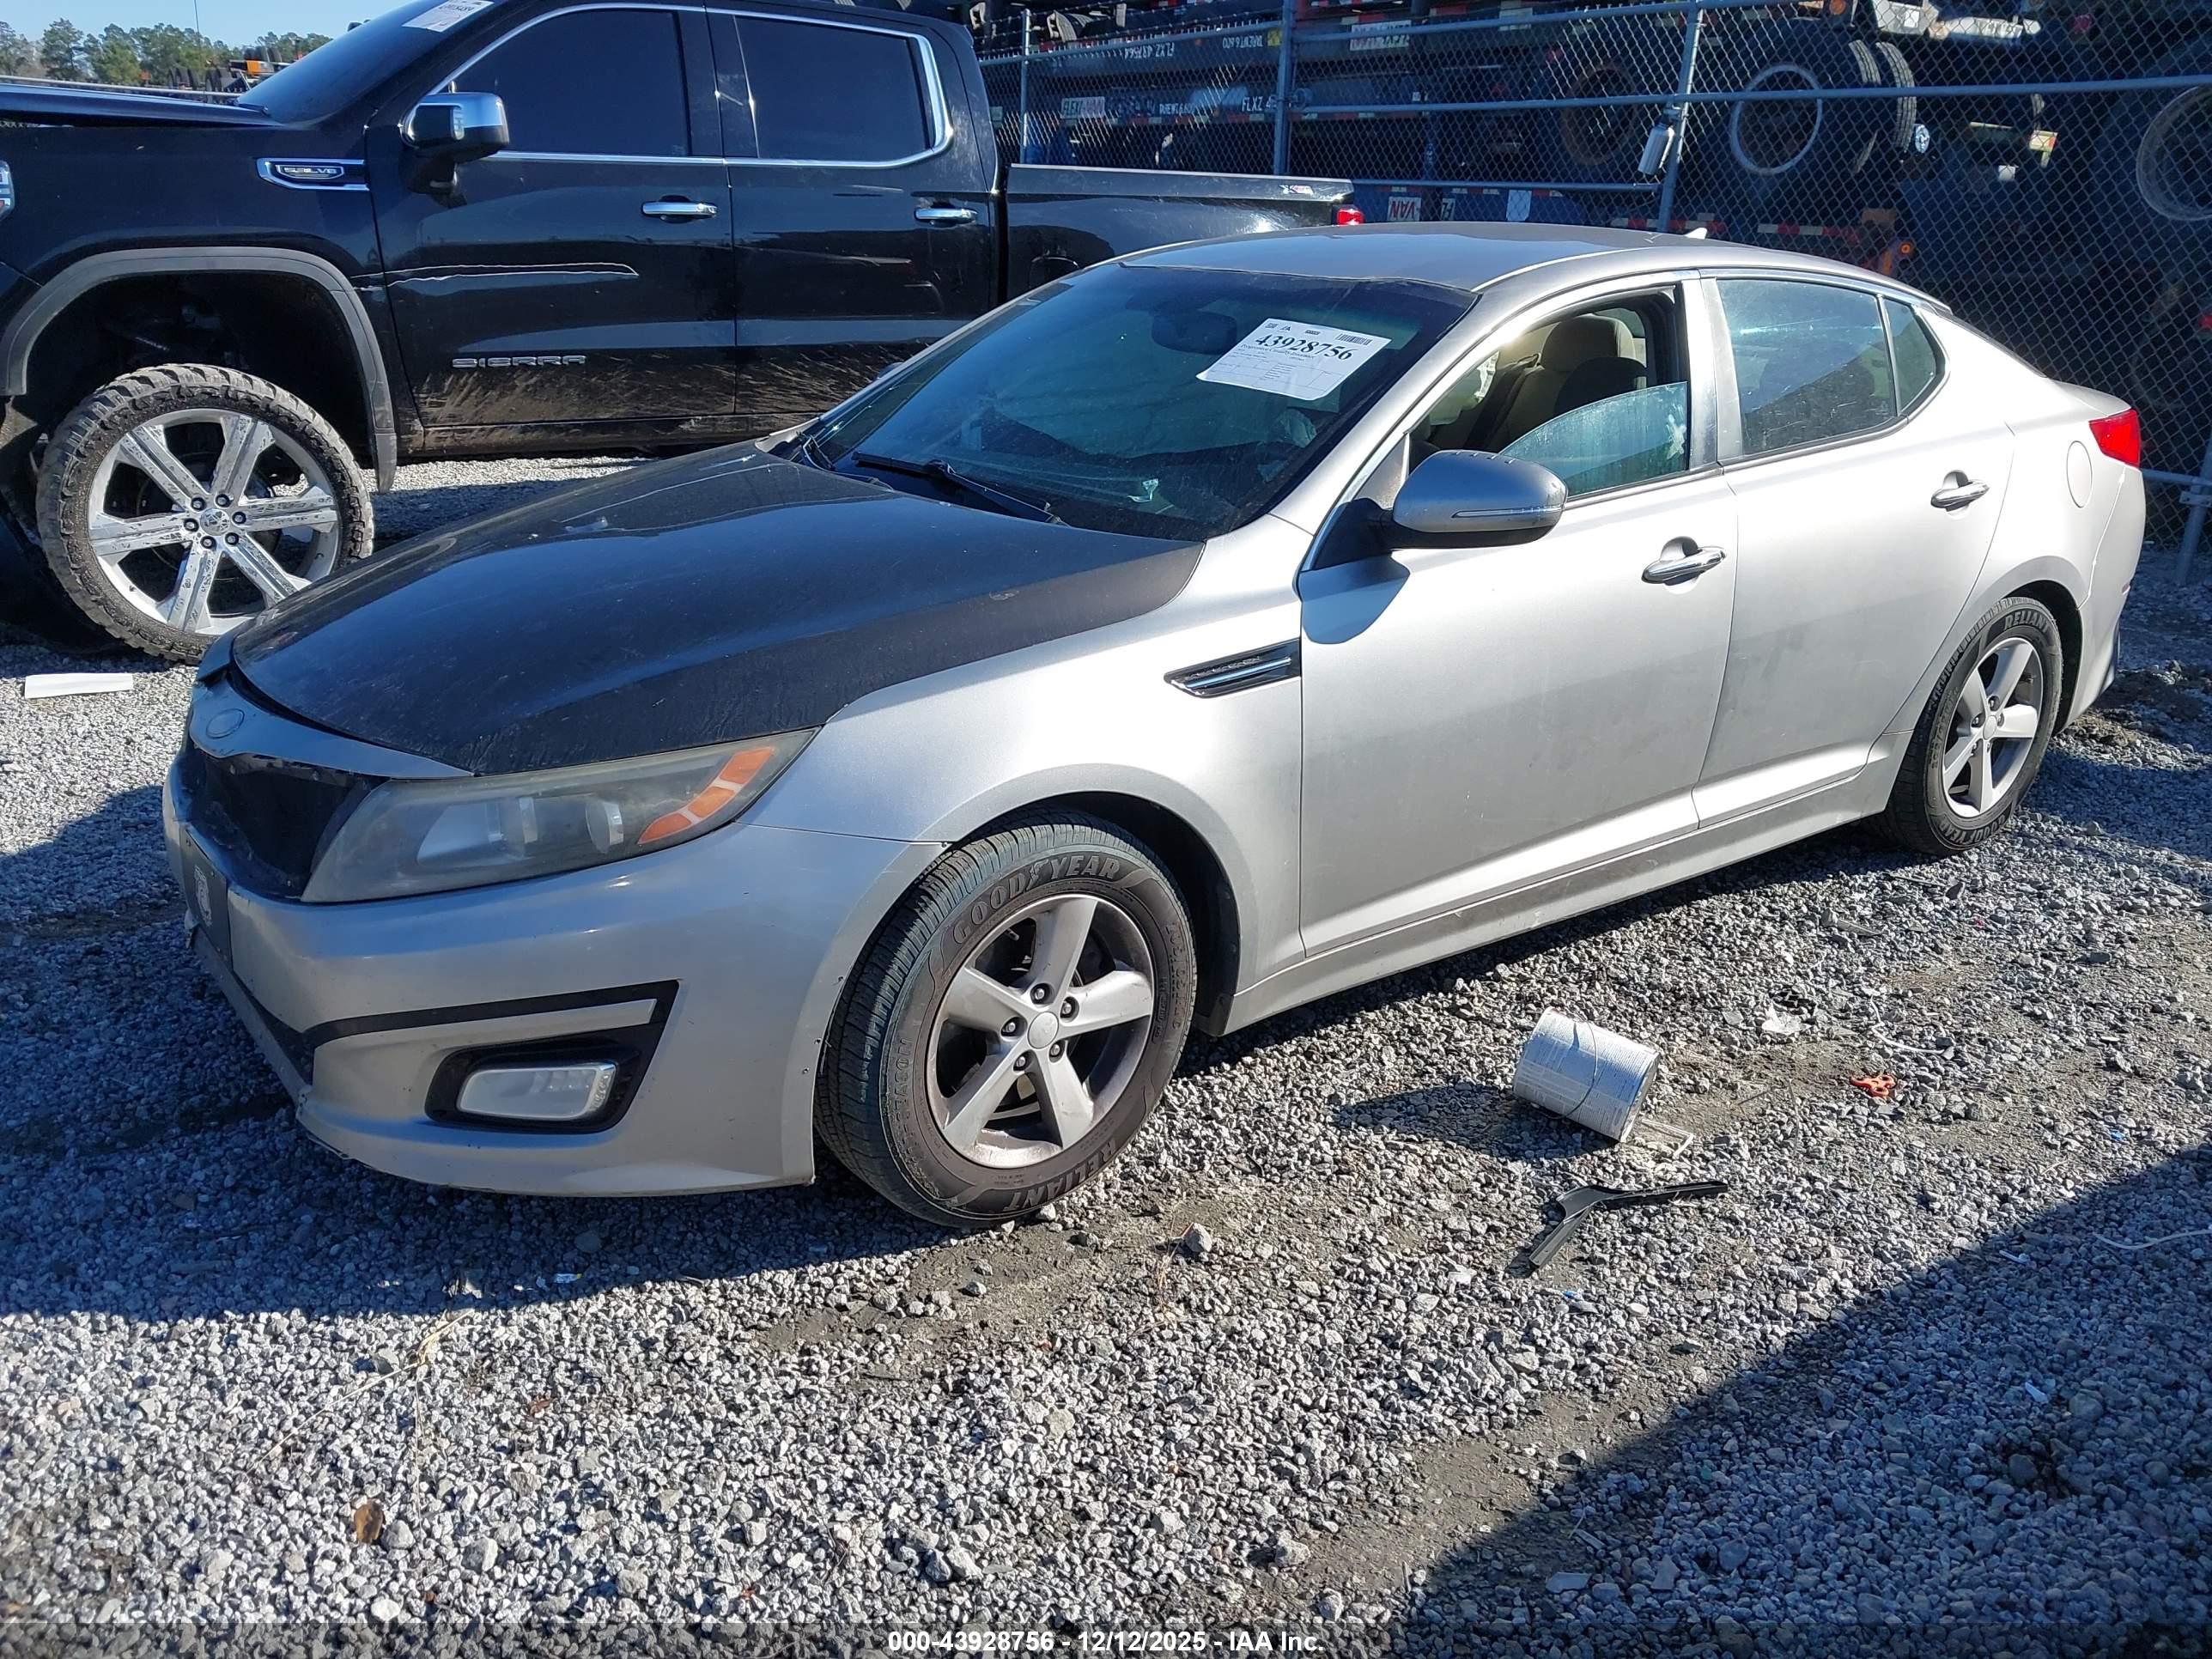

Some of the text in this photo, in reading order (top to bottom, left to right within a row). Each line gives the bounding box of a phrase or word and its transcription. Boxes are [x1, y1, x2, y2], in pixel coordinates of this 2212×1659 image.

[1241, 95, 1264, 112] FLXZ
[1390, 199, 1418, 221] VAN
[1255, 333, 1358, 361] 43928756
[452, 355, 586, 368] SIERRA
[953, 855, 1121, 945] GOODYEAR
[1002, 1137, 1117, 1212] RELIANT
